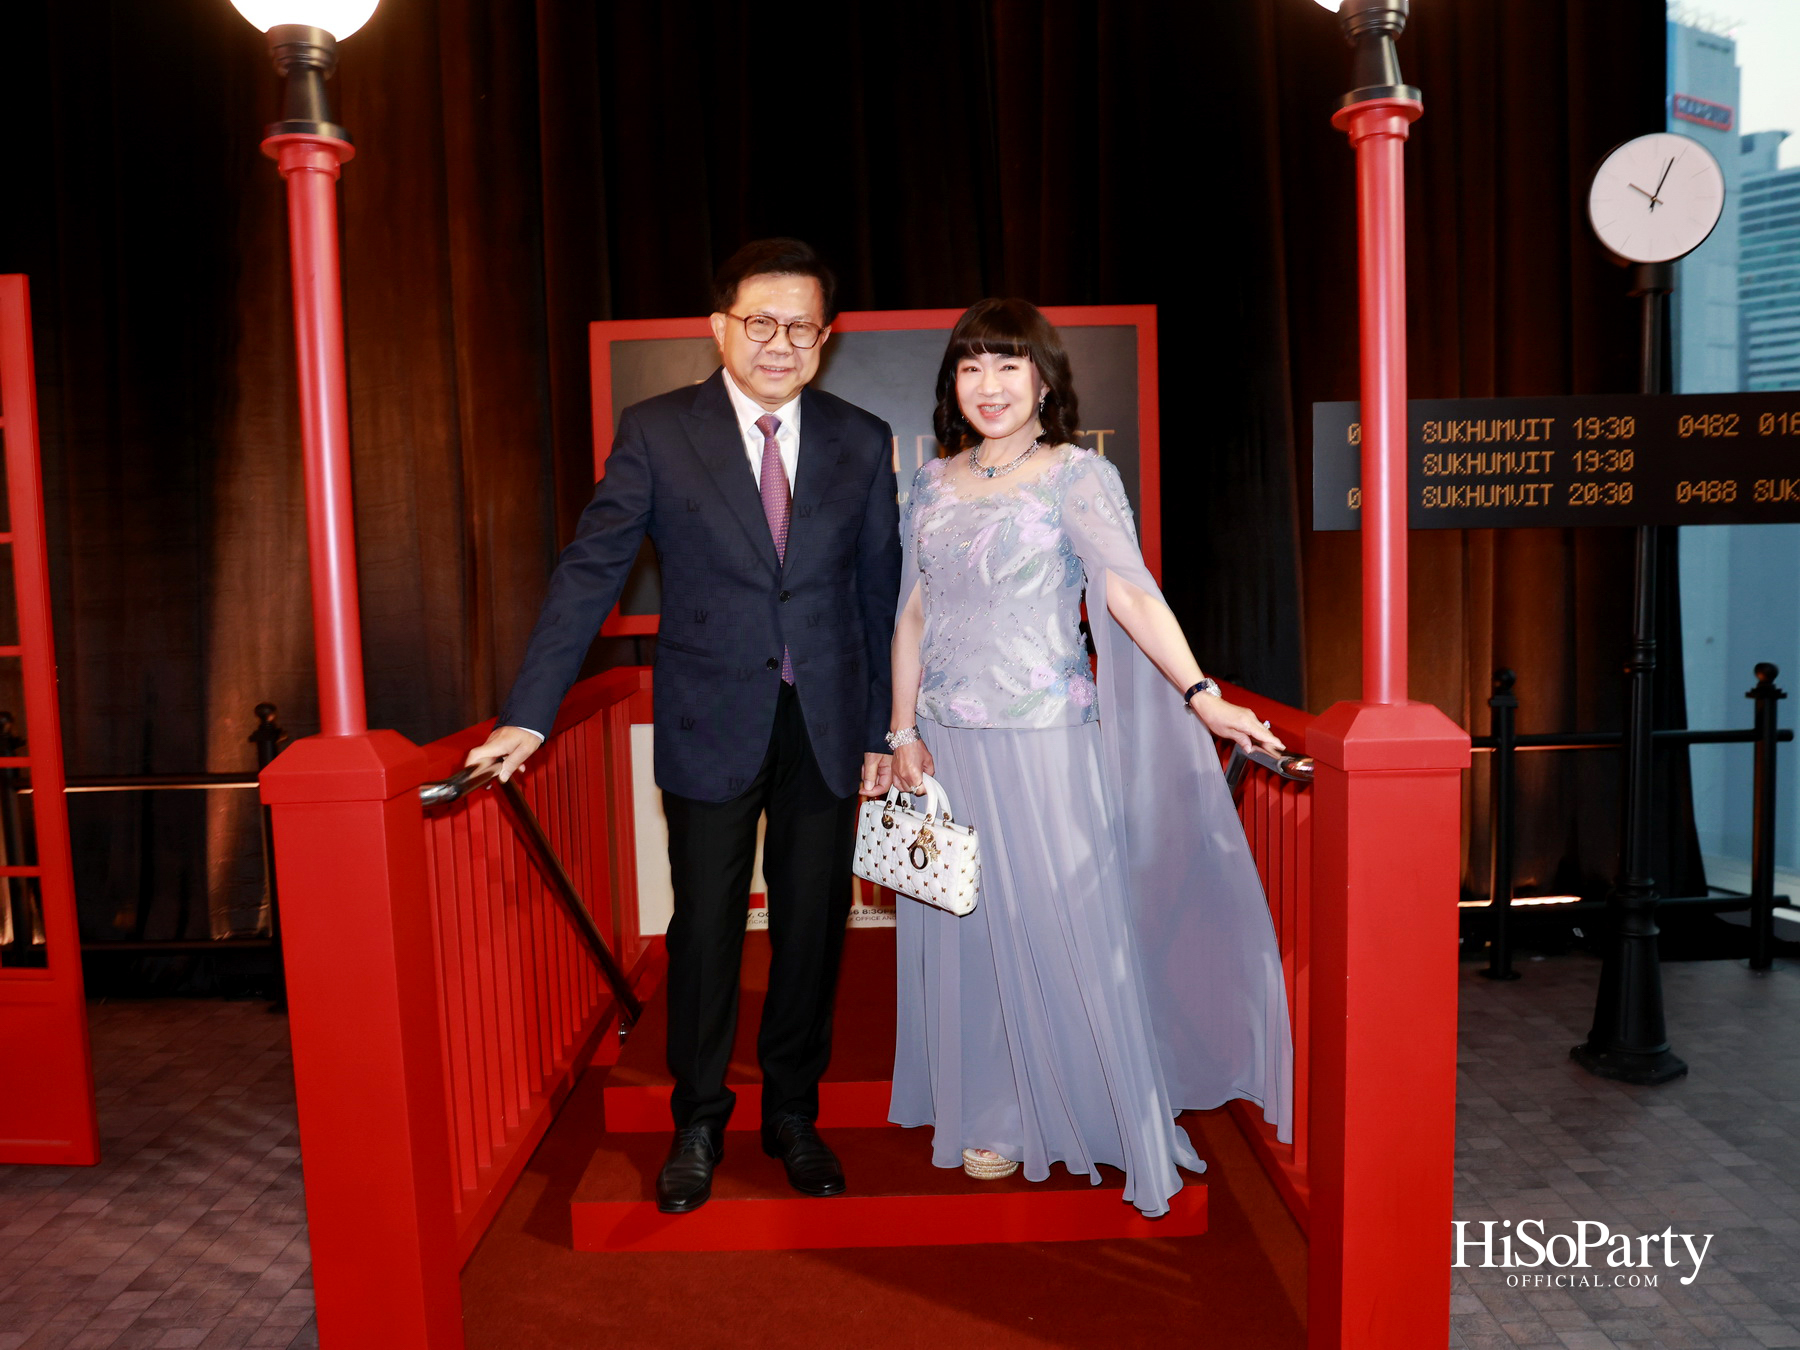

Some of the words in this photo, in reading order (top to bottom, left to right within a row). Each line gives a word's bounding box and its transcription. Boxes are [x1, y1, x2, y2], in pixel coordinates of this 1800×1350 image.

[1422, 418, 1555, 444] SUKHUMVIT
[1572, 416, 1635, 440] 19:30
[1678, 413, 1740, 438] 0482
[1422, 451, 1555, 476] SUKHUMVIT
[1572, 449, 1634, 473] 19:30
[1422, 483, 1554, 508] SUKHUMVIT
[1568, 481, 1633, 506] 20:30
[1676, 480, 1738, 503] 0488
[680, 717, 696, 730] LV
